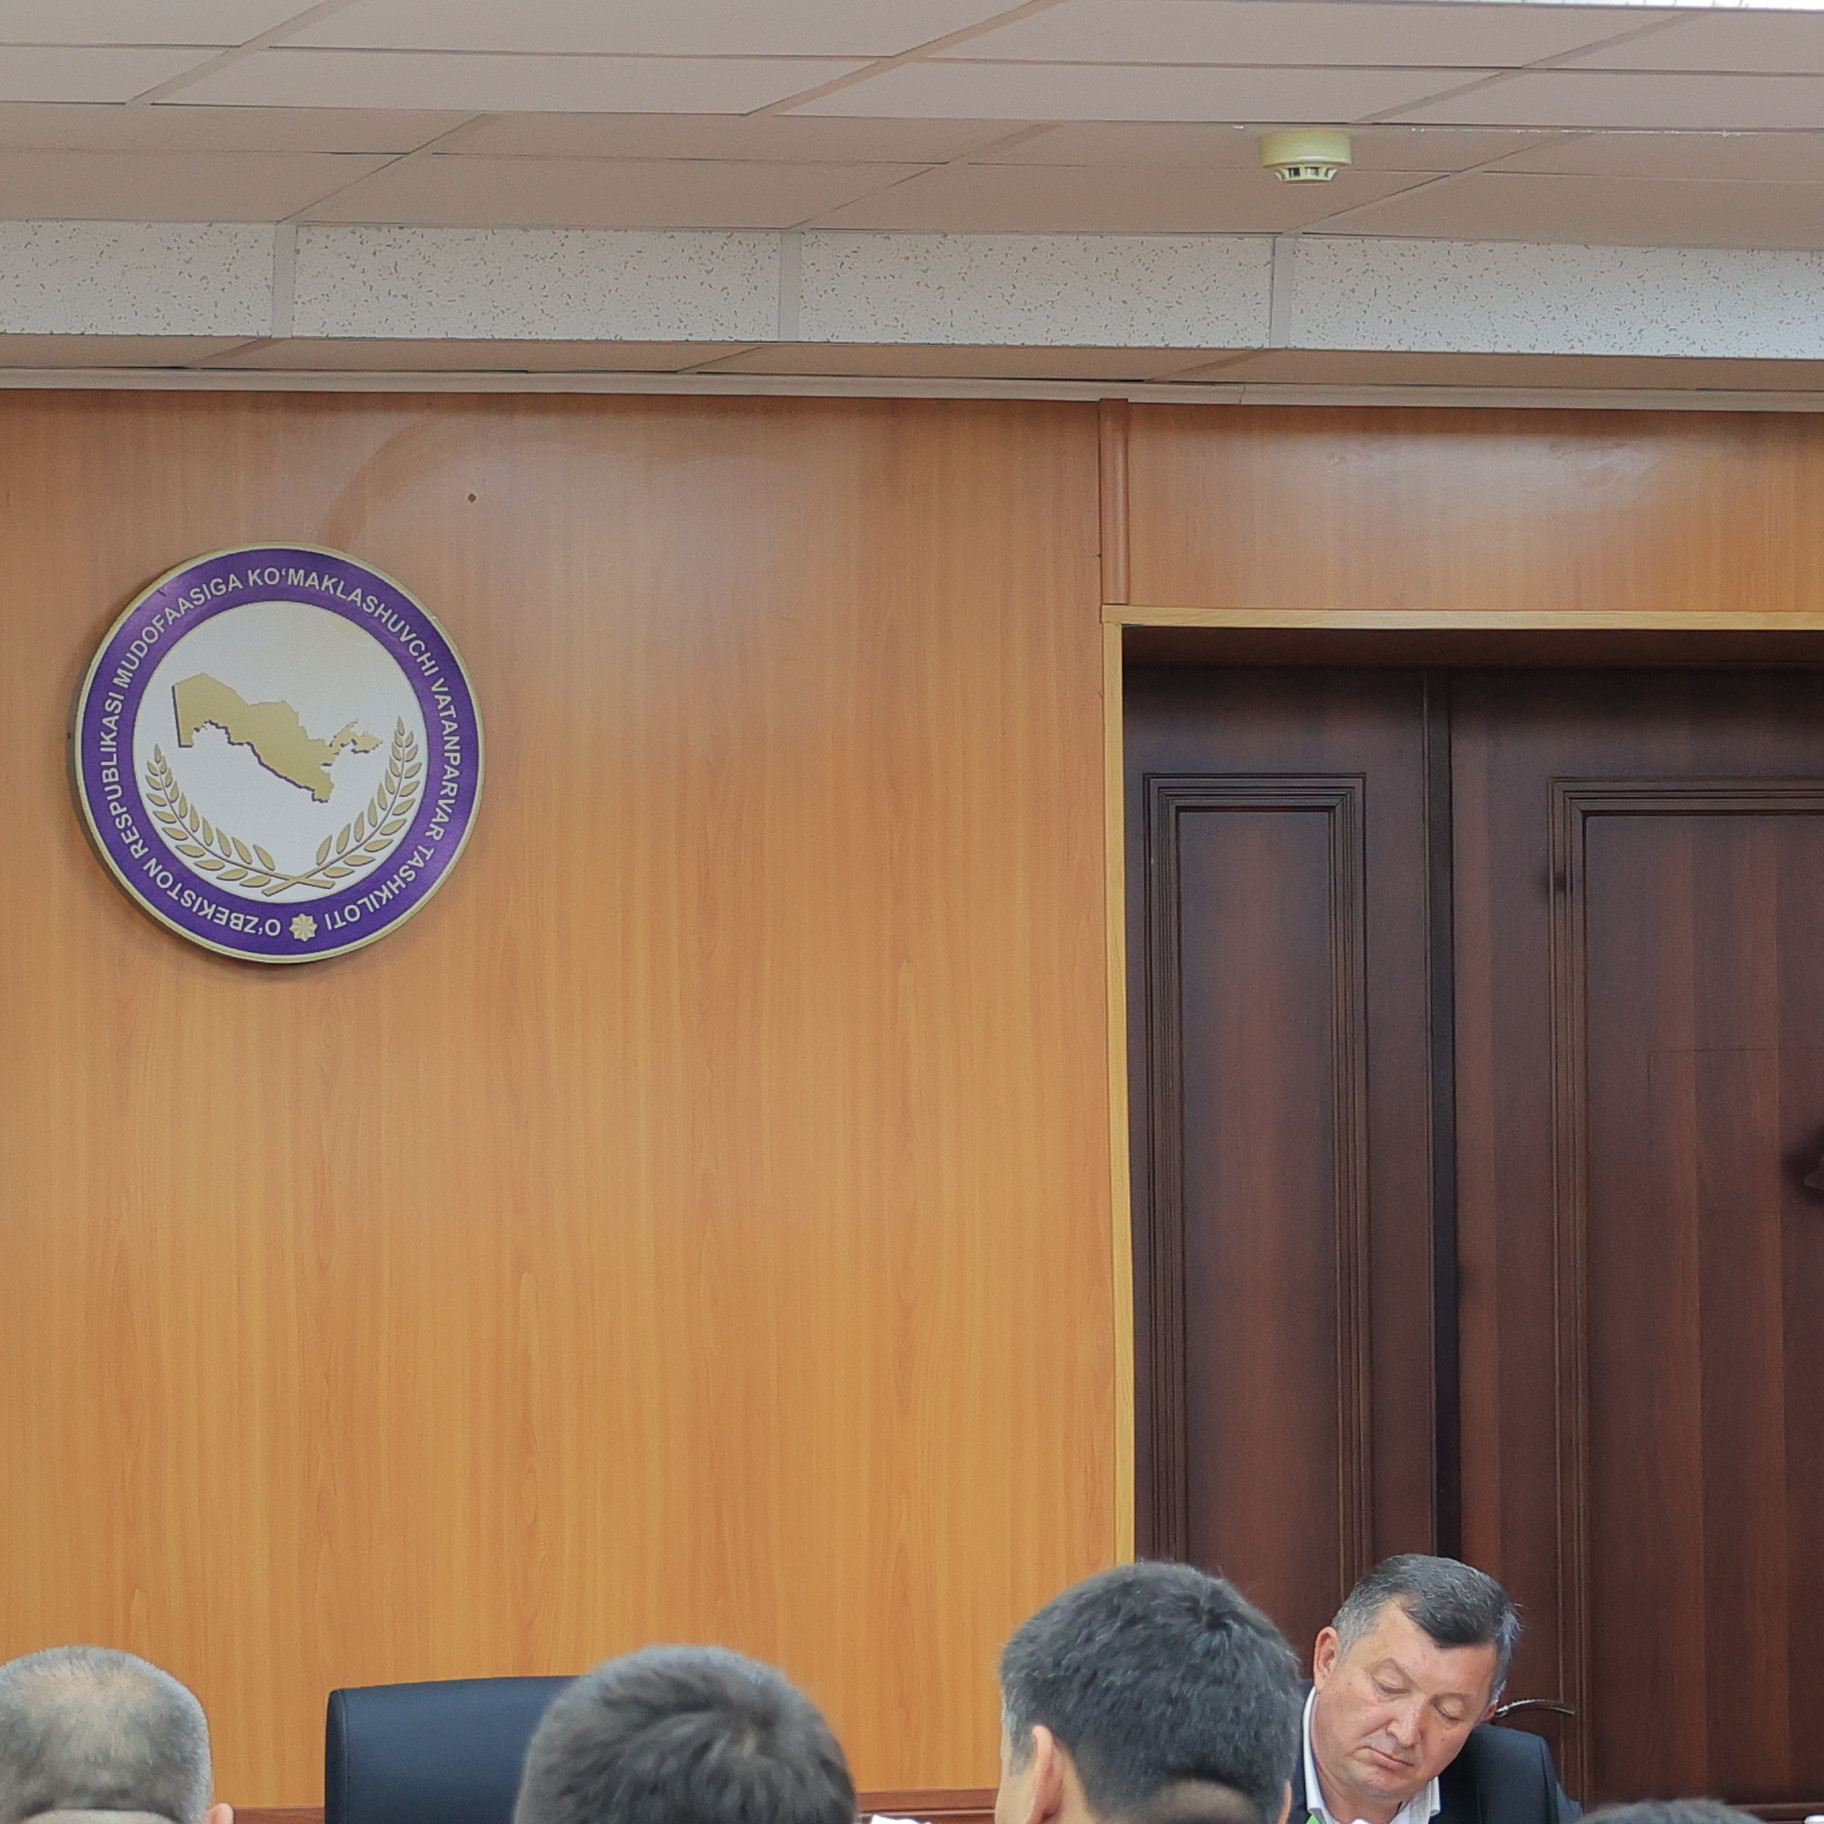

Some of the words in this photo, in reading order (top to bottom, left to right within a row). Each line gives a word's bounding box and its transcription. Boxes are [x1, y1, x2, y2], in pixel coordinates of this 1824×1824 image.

[113, 572, 243, 689] MUDOFAASIGA
[248, 567, 439, 677] KO‘MAKLASHUVCHI
[99, 693, 149, 859] RESPUBLIKASI
[425, 678, 462, 840] VATANPARVAR
[145, 862, 282, 937] O‘ZBEKISTON
[325, 844, 434, 931] TASHKILOTI
